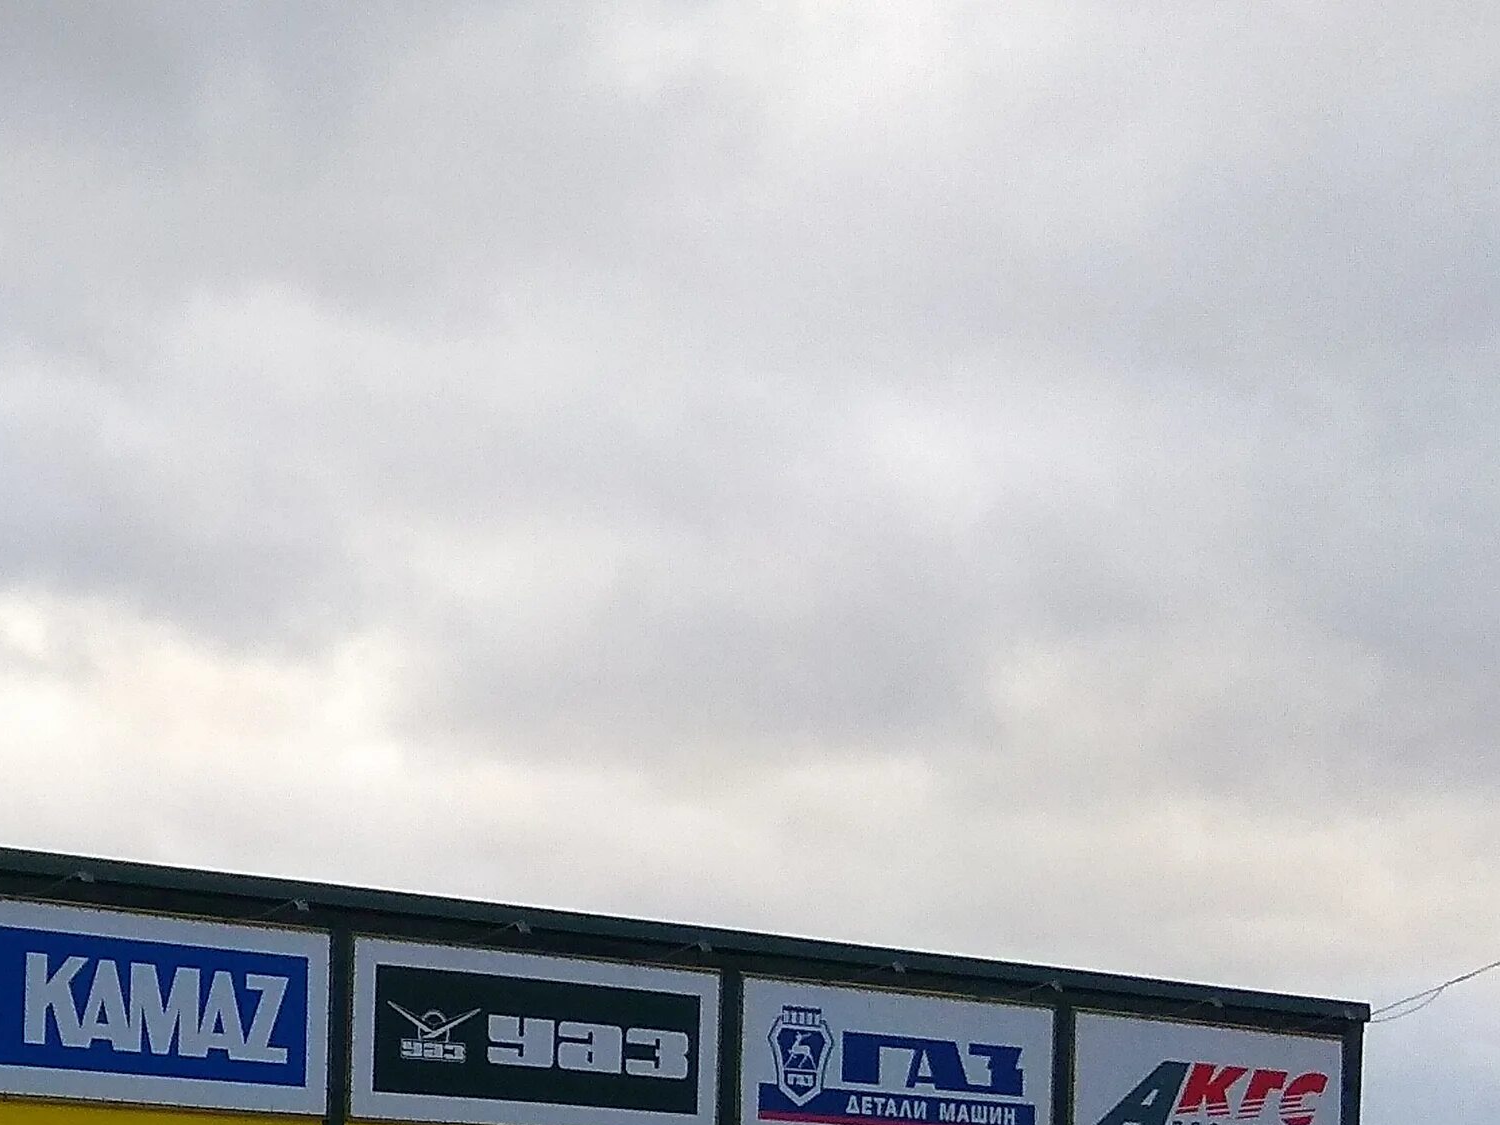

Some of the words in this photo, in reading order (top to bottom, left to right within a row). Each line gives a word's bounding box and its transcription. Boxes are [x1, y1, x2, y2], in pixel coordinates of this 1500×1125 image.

[24, 951, 289, 1065] KAMAZ
[841, 1030, 1024, 1097] ГАЗ
[845, 1095, 927, 1121] ДЕТАЛИ
[938, 1102, 1016, 1125] МАШИН
